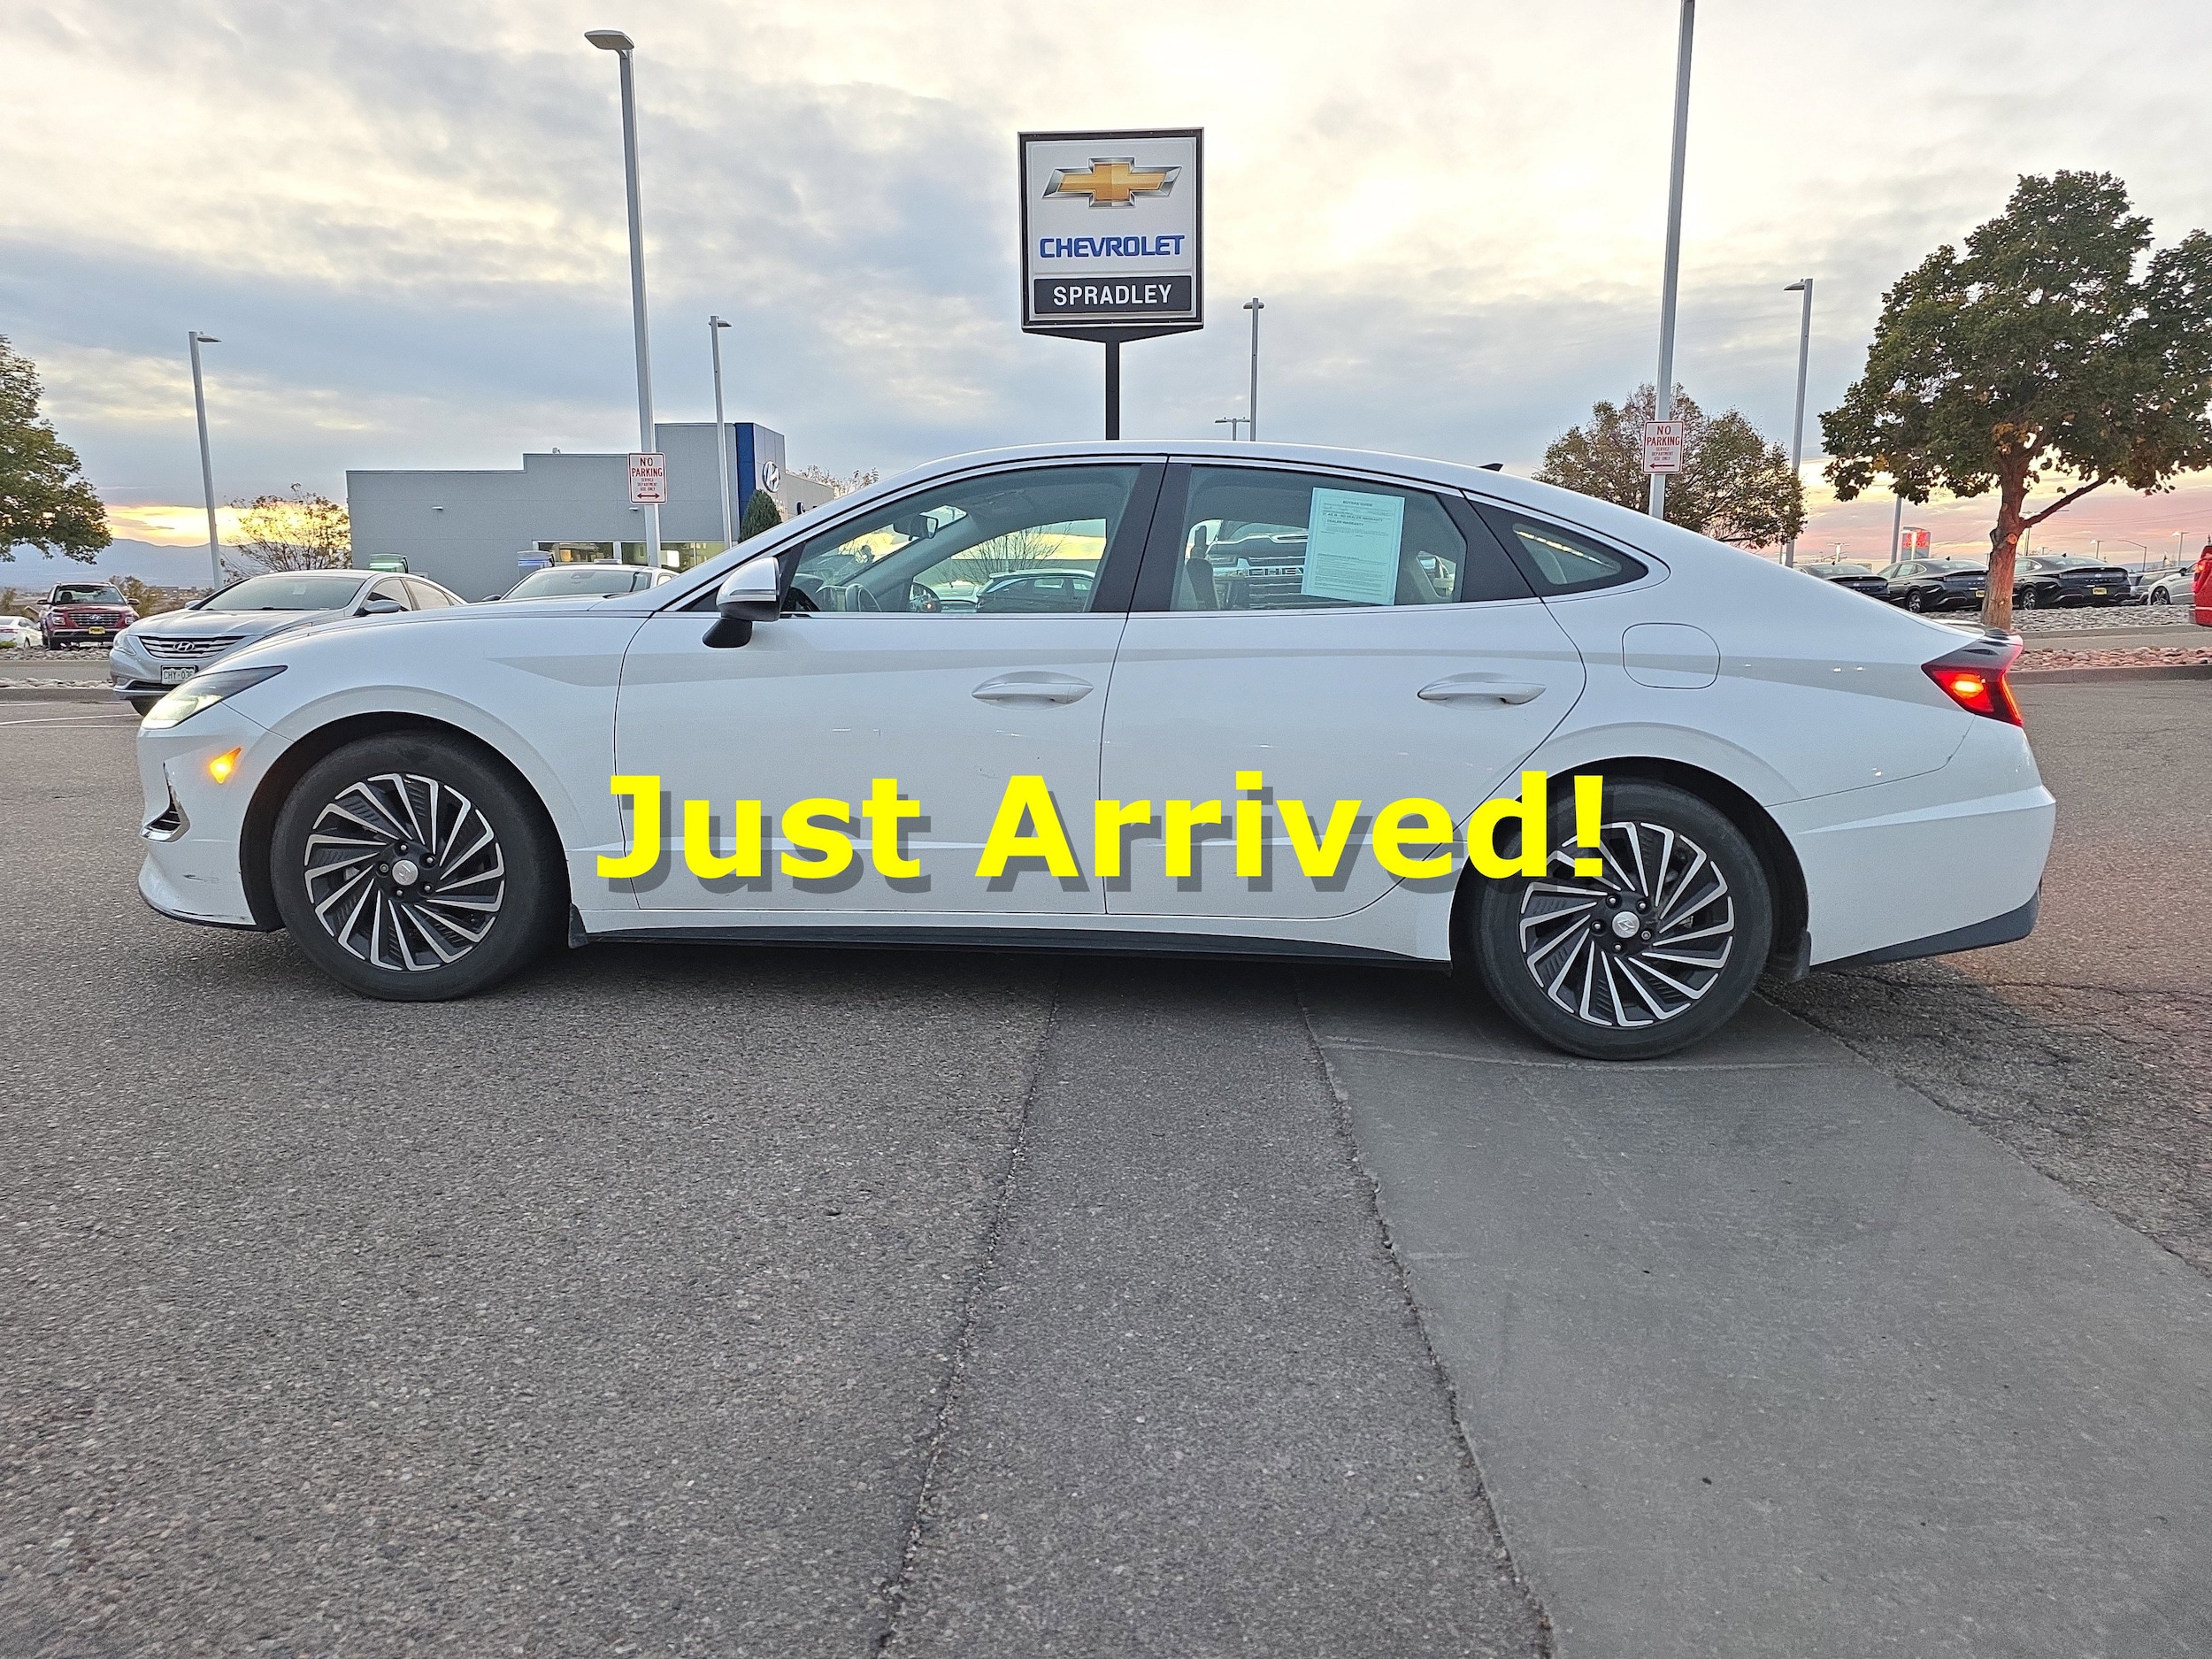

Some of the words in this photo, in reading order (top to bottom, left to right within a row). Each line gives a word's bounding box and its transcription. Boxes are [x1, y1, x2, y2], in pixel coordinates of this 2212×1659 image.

[1039, 234, 1186, 258] CHEVROLET
[1052, 283, 1173, 306] SPRADLEY
[1656, 425, 1671, 435] NO
[1647, 435, 1680, 446] PARKING
[640, 457, 654, 466] NO
[631, 467, 663, 477] PARKING
